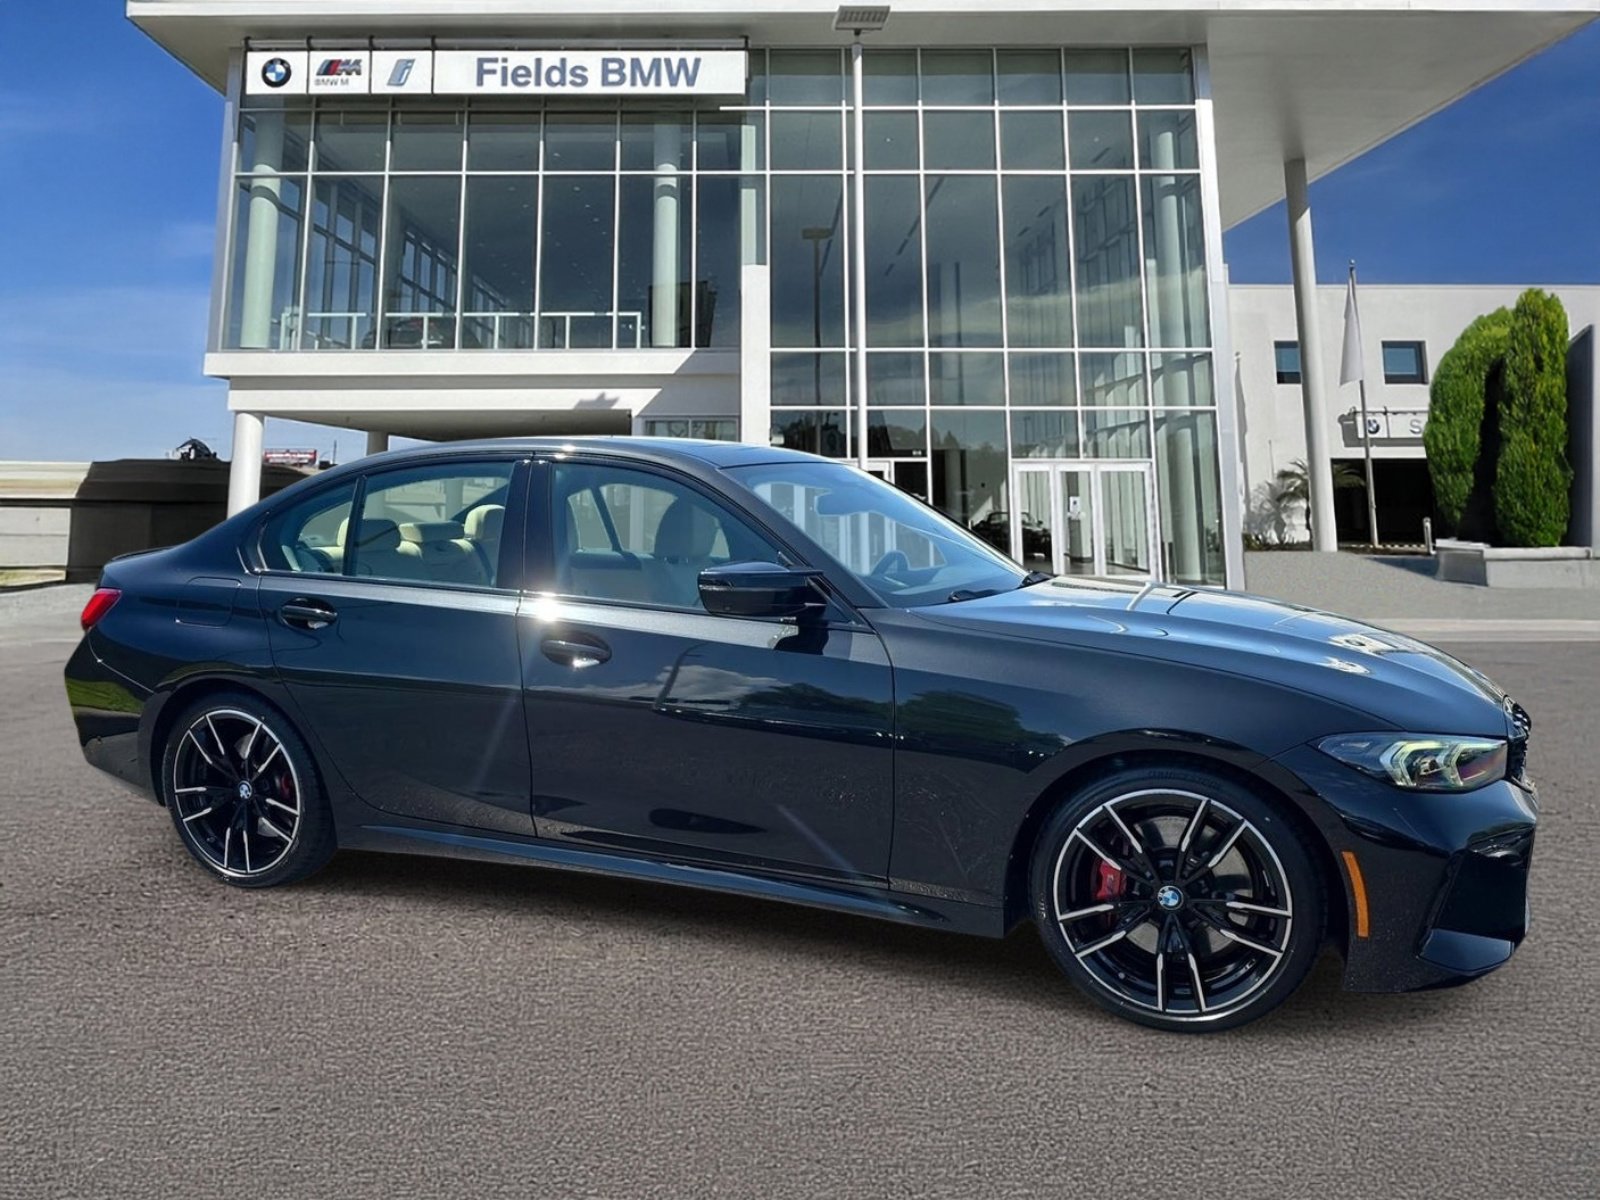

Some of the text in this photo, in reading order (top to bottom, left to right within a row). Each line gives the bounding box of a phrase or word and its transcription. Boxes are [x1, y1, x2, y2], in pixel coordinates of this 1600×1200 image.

[314, 78, 350, 87] BMW M
[476, 57, 702, 88] Fields BMW
